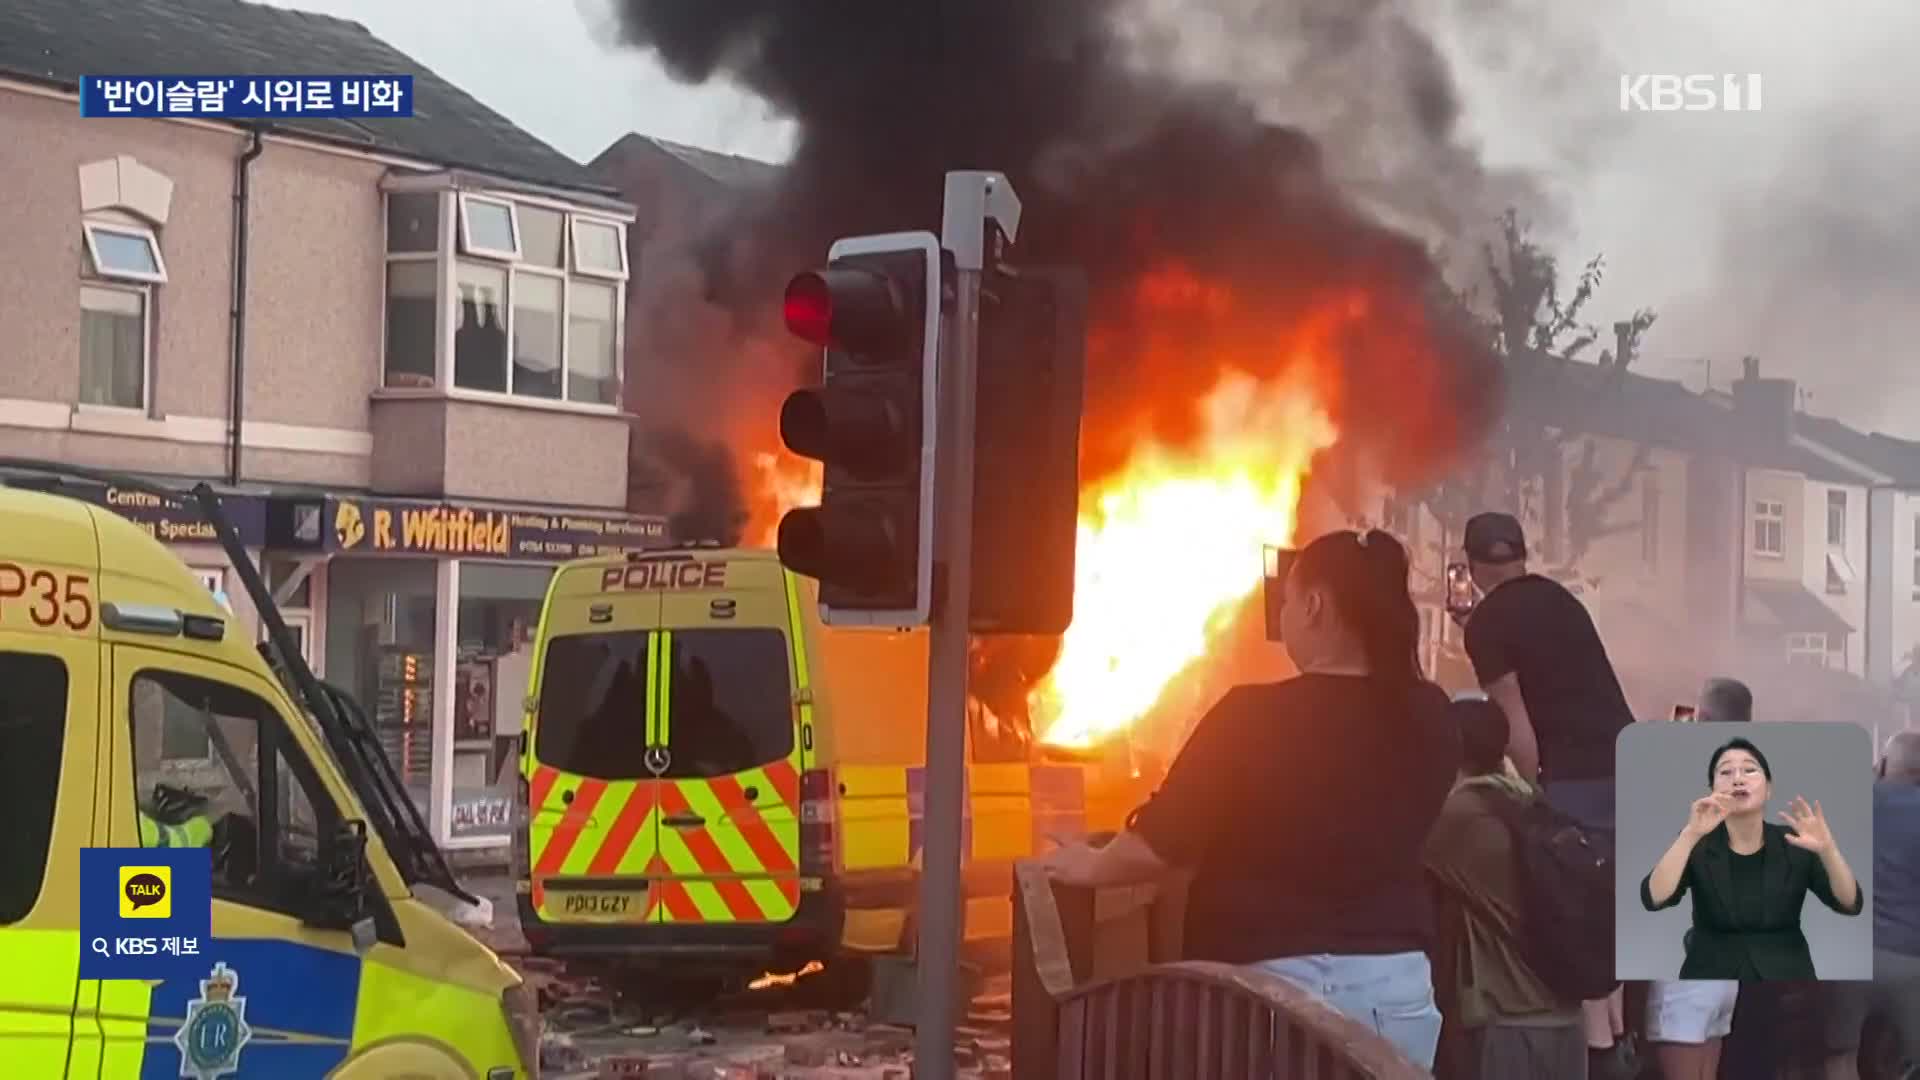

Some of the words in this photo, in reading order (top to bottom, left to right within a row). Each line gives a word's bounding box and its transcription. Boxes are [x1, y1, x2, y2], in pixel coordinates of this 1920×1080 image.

[374, 509, 397, 549] R.
[402, 507, 509, 554] Whitfield
[601, 561, 727, 592] POLICE
